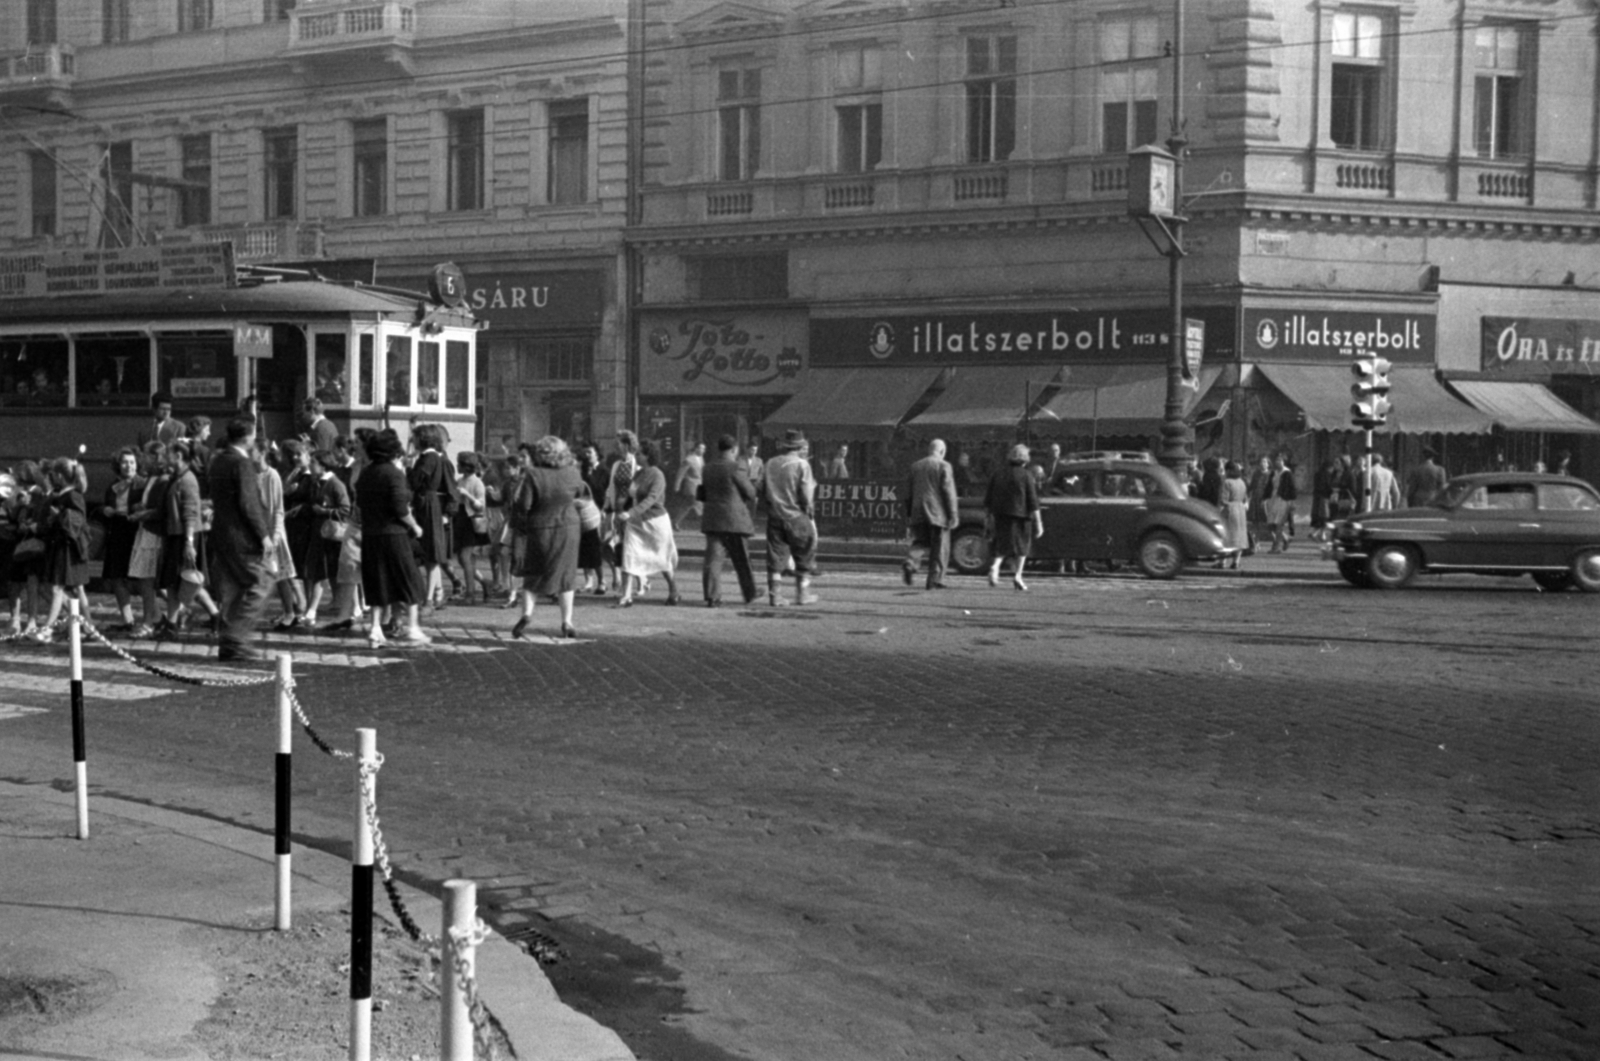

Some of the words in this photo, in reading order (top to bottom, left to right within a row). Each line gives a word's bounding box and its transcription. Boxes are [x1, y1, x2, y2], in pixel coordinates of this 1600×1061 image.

[913, 317, 1121, 353] illatszerbolt
[1284, 314, 1420, 349] illatszerbolt
[1497, 321, 1550, 361] ÓRA
